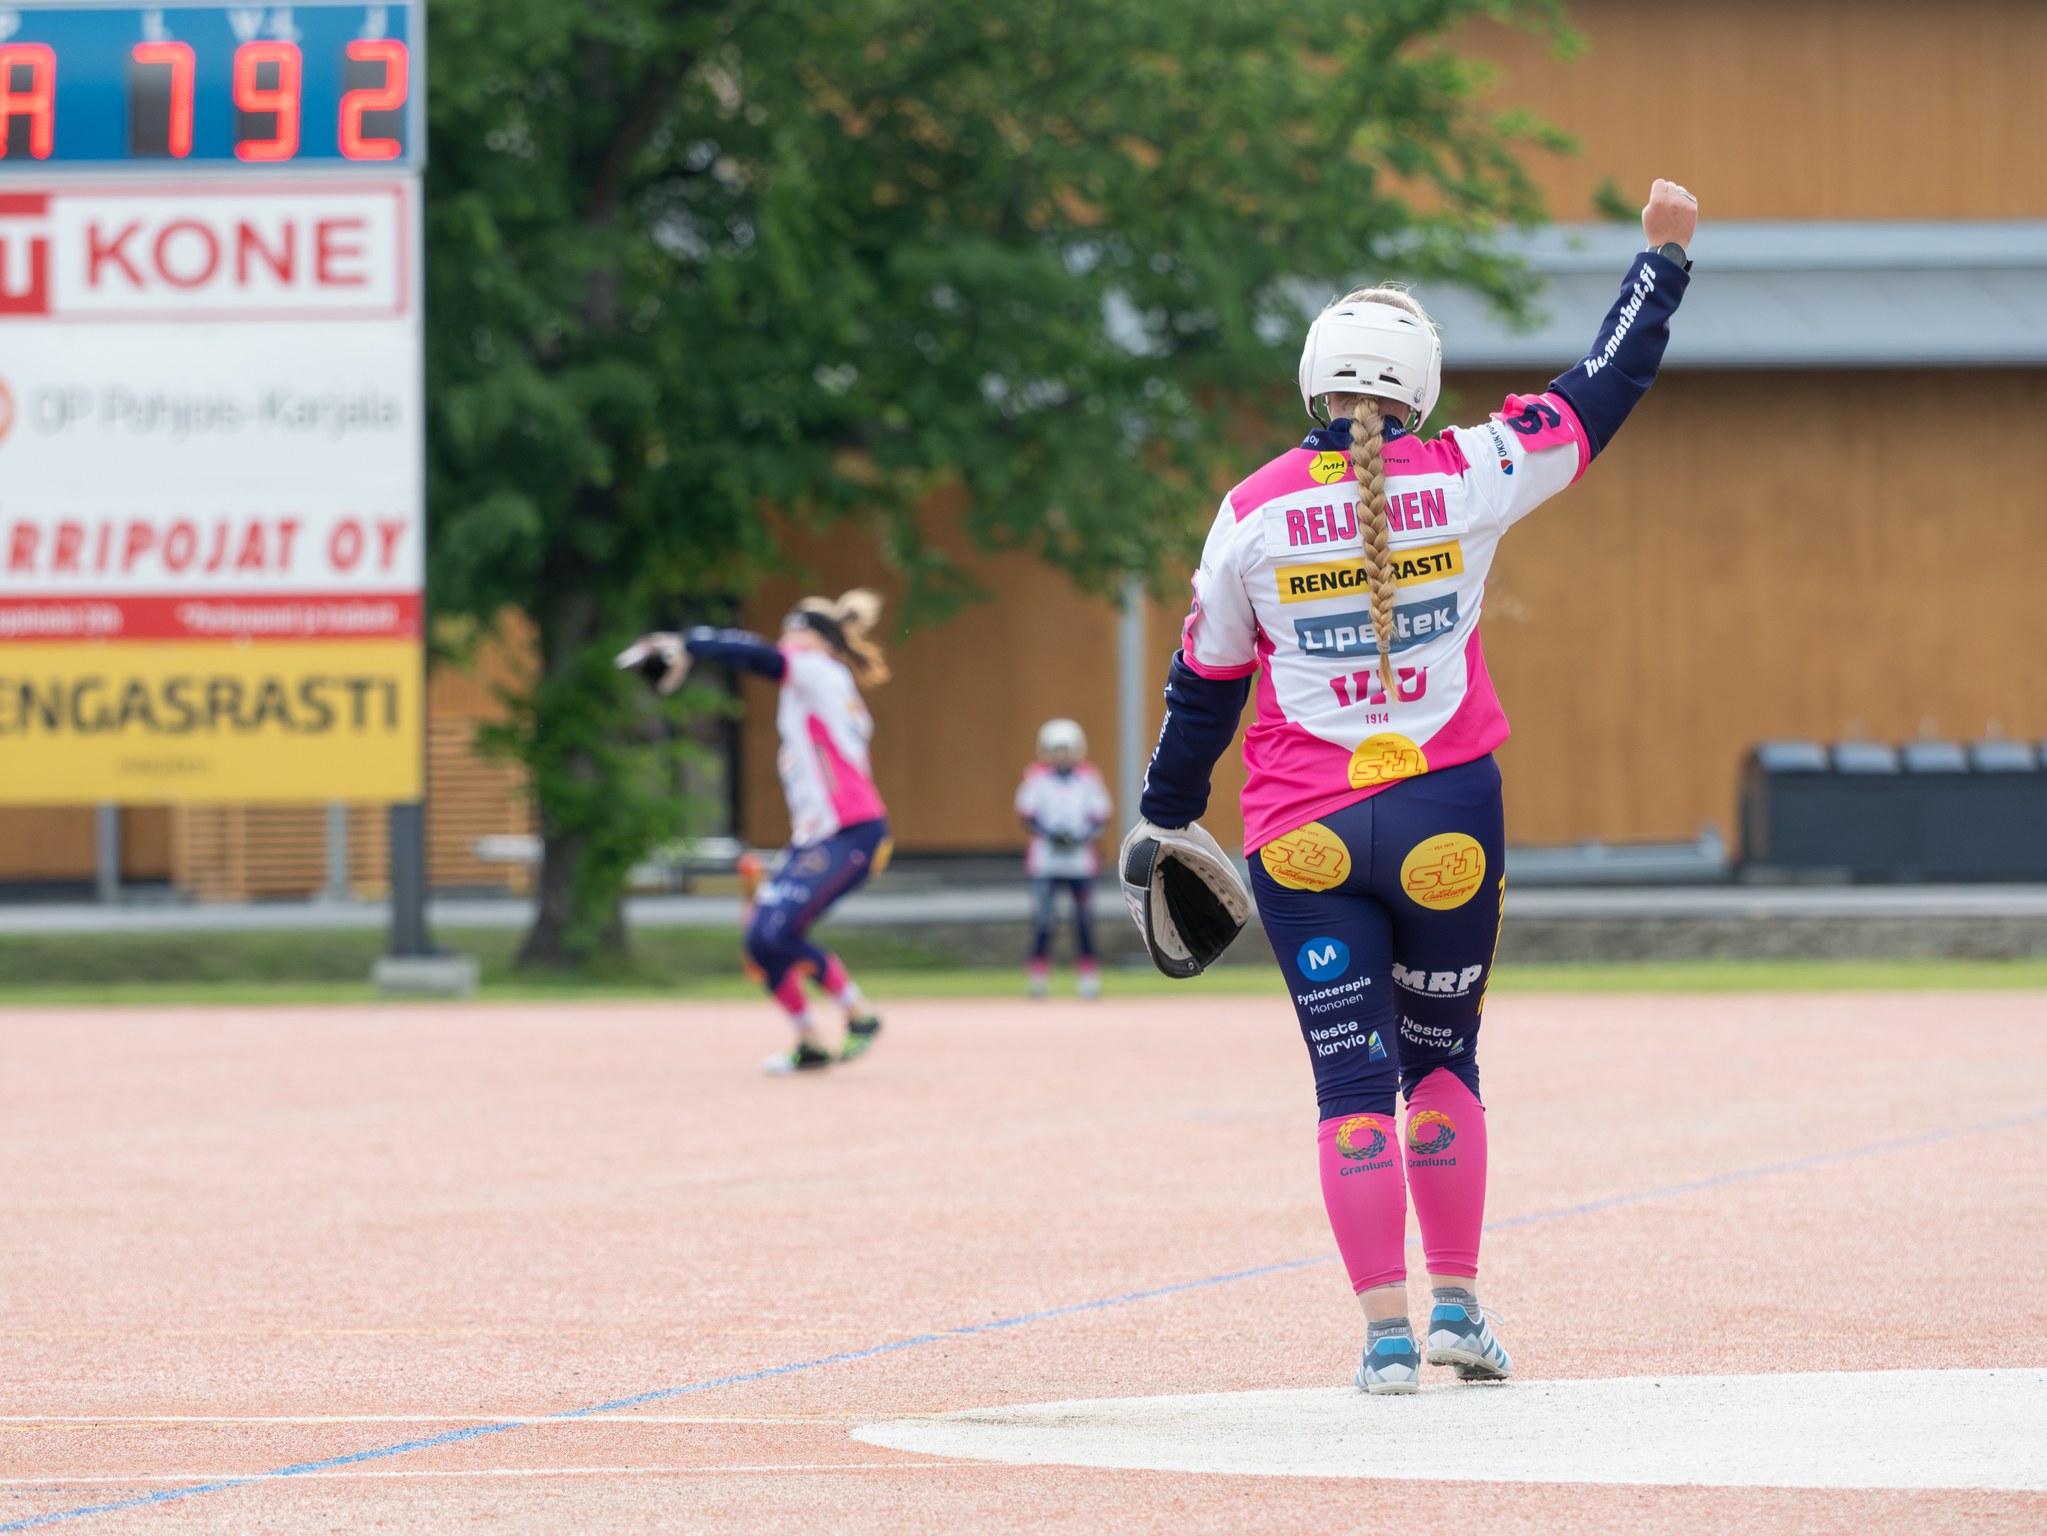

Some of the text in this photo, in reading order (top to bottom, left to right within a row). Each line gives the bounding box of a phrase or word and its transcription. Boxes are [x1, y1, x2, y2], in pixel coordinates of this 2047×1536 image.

[132, 41, 195, 158] 7
[234, 40, 302, 161] 9
[339, 39, 408, 160] 2
[86, 217, 369, 290] KONE
[1323, 461, 1345, 470] MH
[1286, 488, 1448, 546] REIJNEN
[327, 518, 408, 574] OY
[1290, 552, 1453, 595] RENGARASTI
[1365, 712, 1389, 725] 1914
[1307, 944, 1337, 970] M
[1392, 962, 1482, 993] MRP
[1297, 976, 1372, 1005] Fysioterapia
[1310, 993, 1364, 1016] Mononen
[1310, 1020, 1359, 1042] Neste
[1400, 1026, 1452, 1048] Karvio
[1402, 1015, 1453, 1037] Neste
[1316, 1034, 1366, 1057] Karvio
[1340, 1159, 1394, 1177] Granlund
[1407, 1157, 1457, 1168] Granlund
